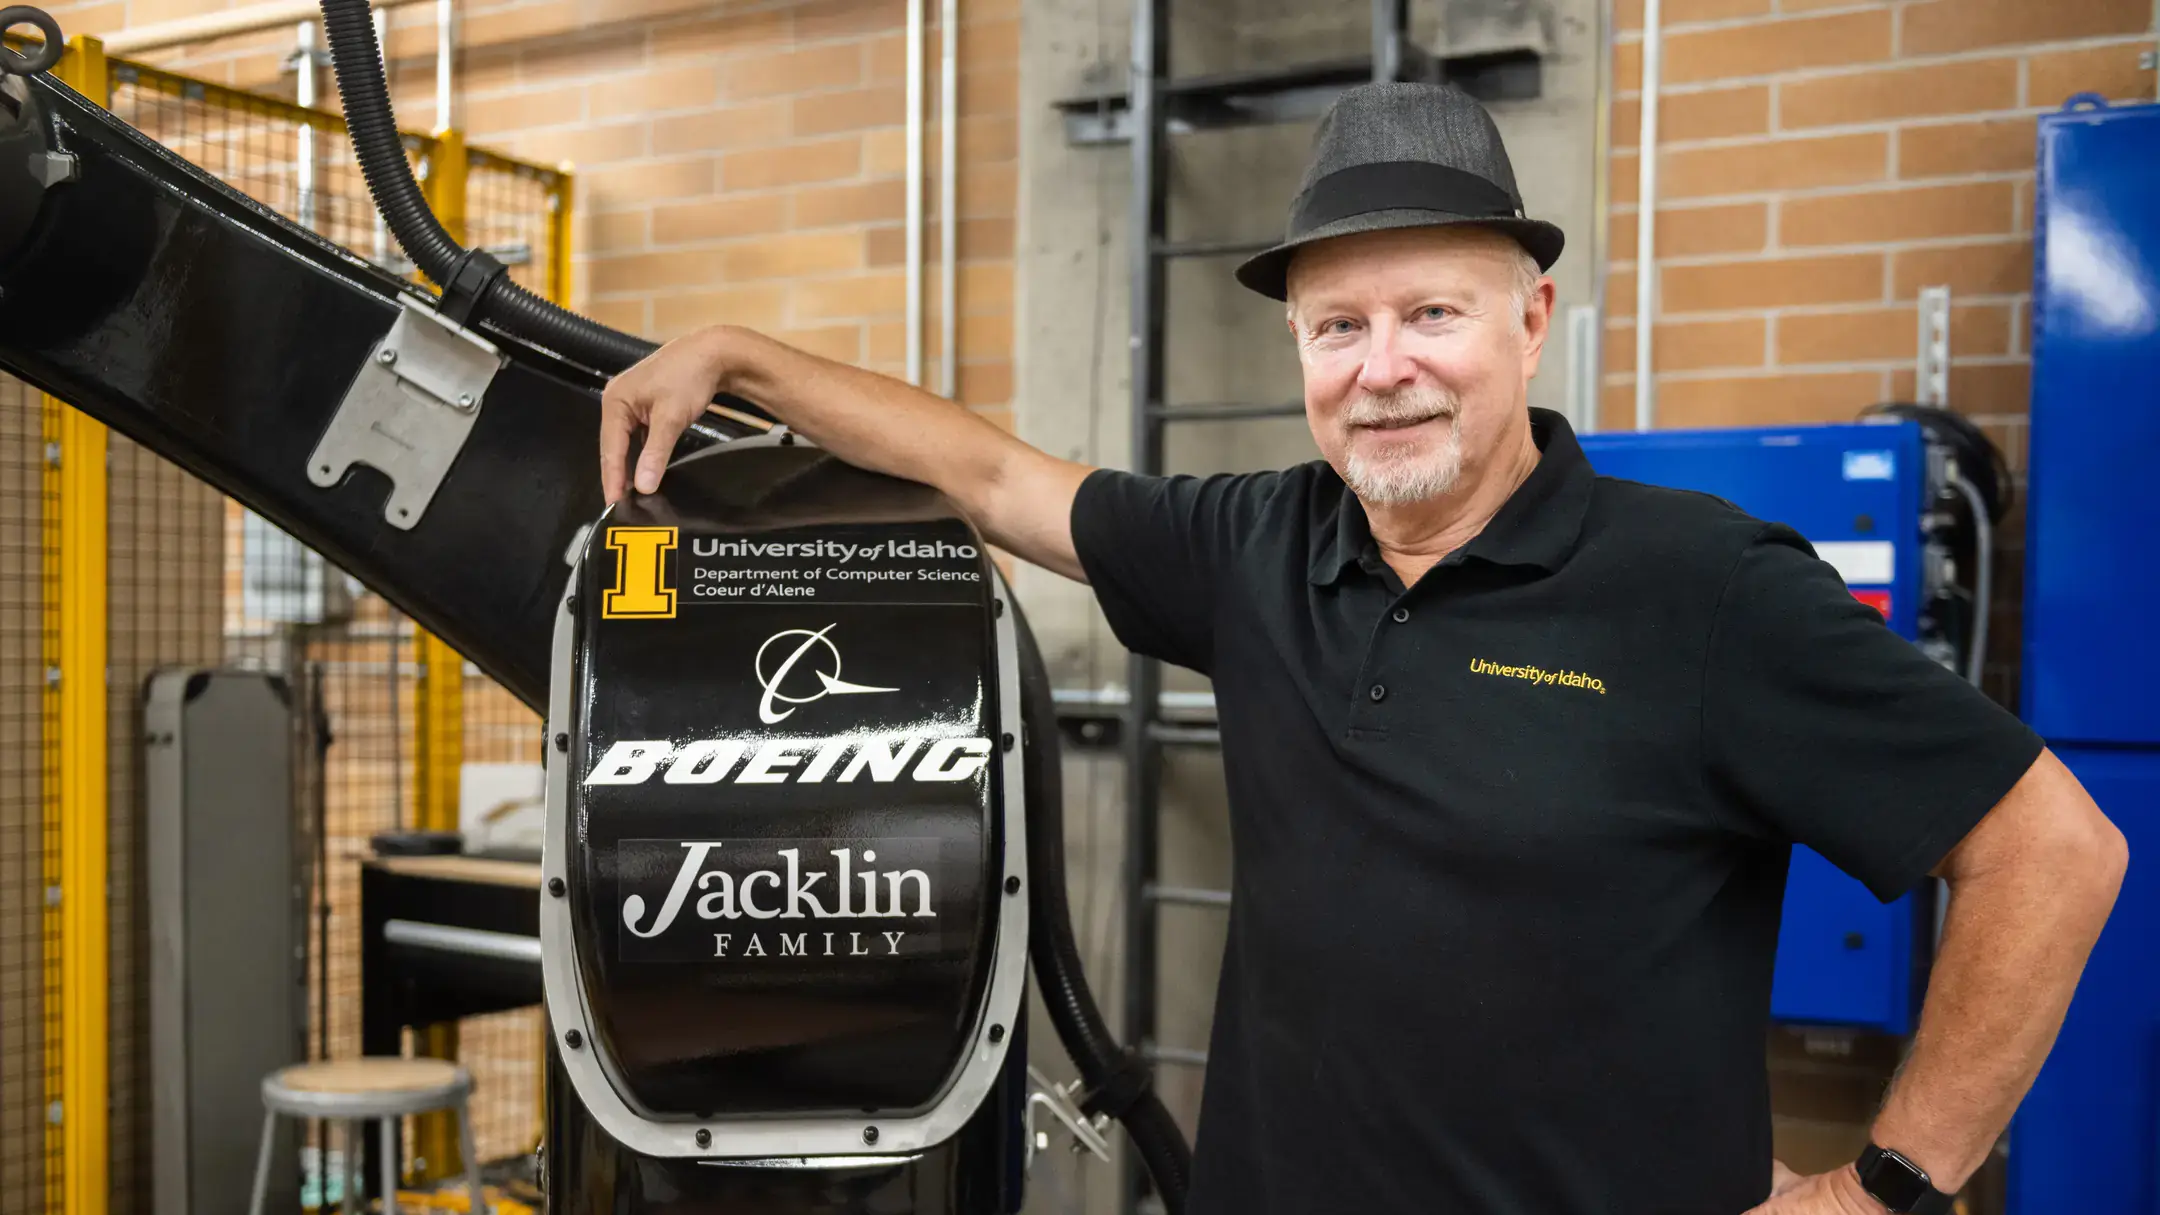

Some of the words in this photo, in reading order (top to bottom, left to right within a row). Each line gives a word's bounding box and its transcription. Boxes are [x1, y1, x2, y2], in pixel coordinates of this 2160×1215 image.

[693, 538, 858, 564] University
[859, 544, 885, 561] of
[888, 540, 978, 559] Idaho
[602, 526, 679, 619] I
[694, 567, 799, 583] Department
[803, 567, 822, 580] of
[826, 568, 913, 583] Computer
[917, 569, 980, 582] Science
[693, 583, 746, 597] Coeur
[750, 583, 816, 597] d'Alene
[1469, 658, 1545, 686] University
[1544, 672, 1558, 685] of
[583, 738, 993, 785] BOEING
[622, 841, 937, 938] Jacklin
[713, 931, 905, 957] FAMILY
